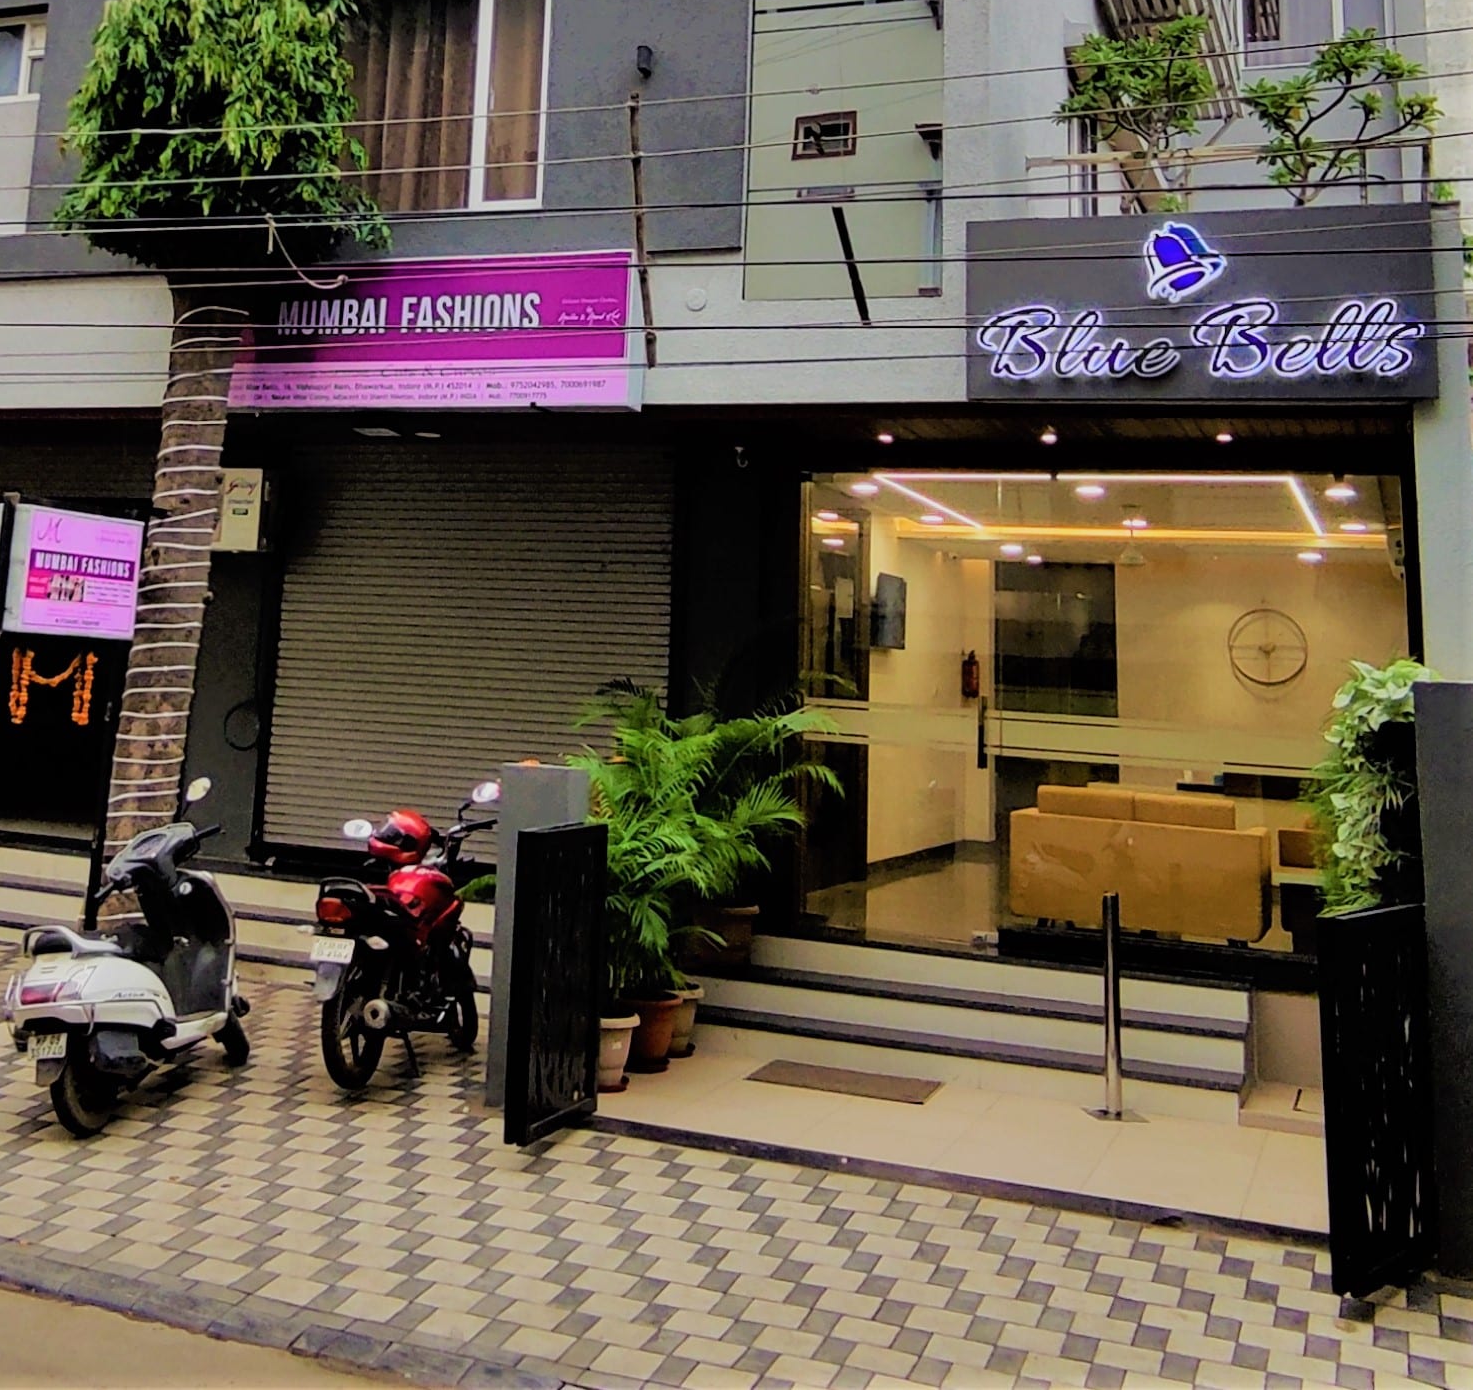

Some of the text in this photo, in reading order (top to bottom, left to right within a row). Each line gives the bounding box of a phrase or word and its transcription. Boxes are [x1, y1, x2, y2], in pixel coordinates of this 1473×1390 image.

[278, 297, 388, 335] MUMBAI
[400, 293, 541, 333] FASHIONS
[977, 298, 1424, 379] Blue Bells
[35, 551, 131, 578] MUMBAI FASHIONS
